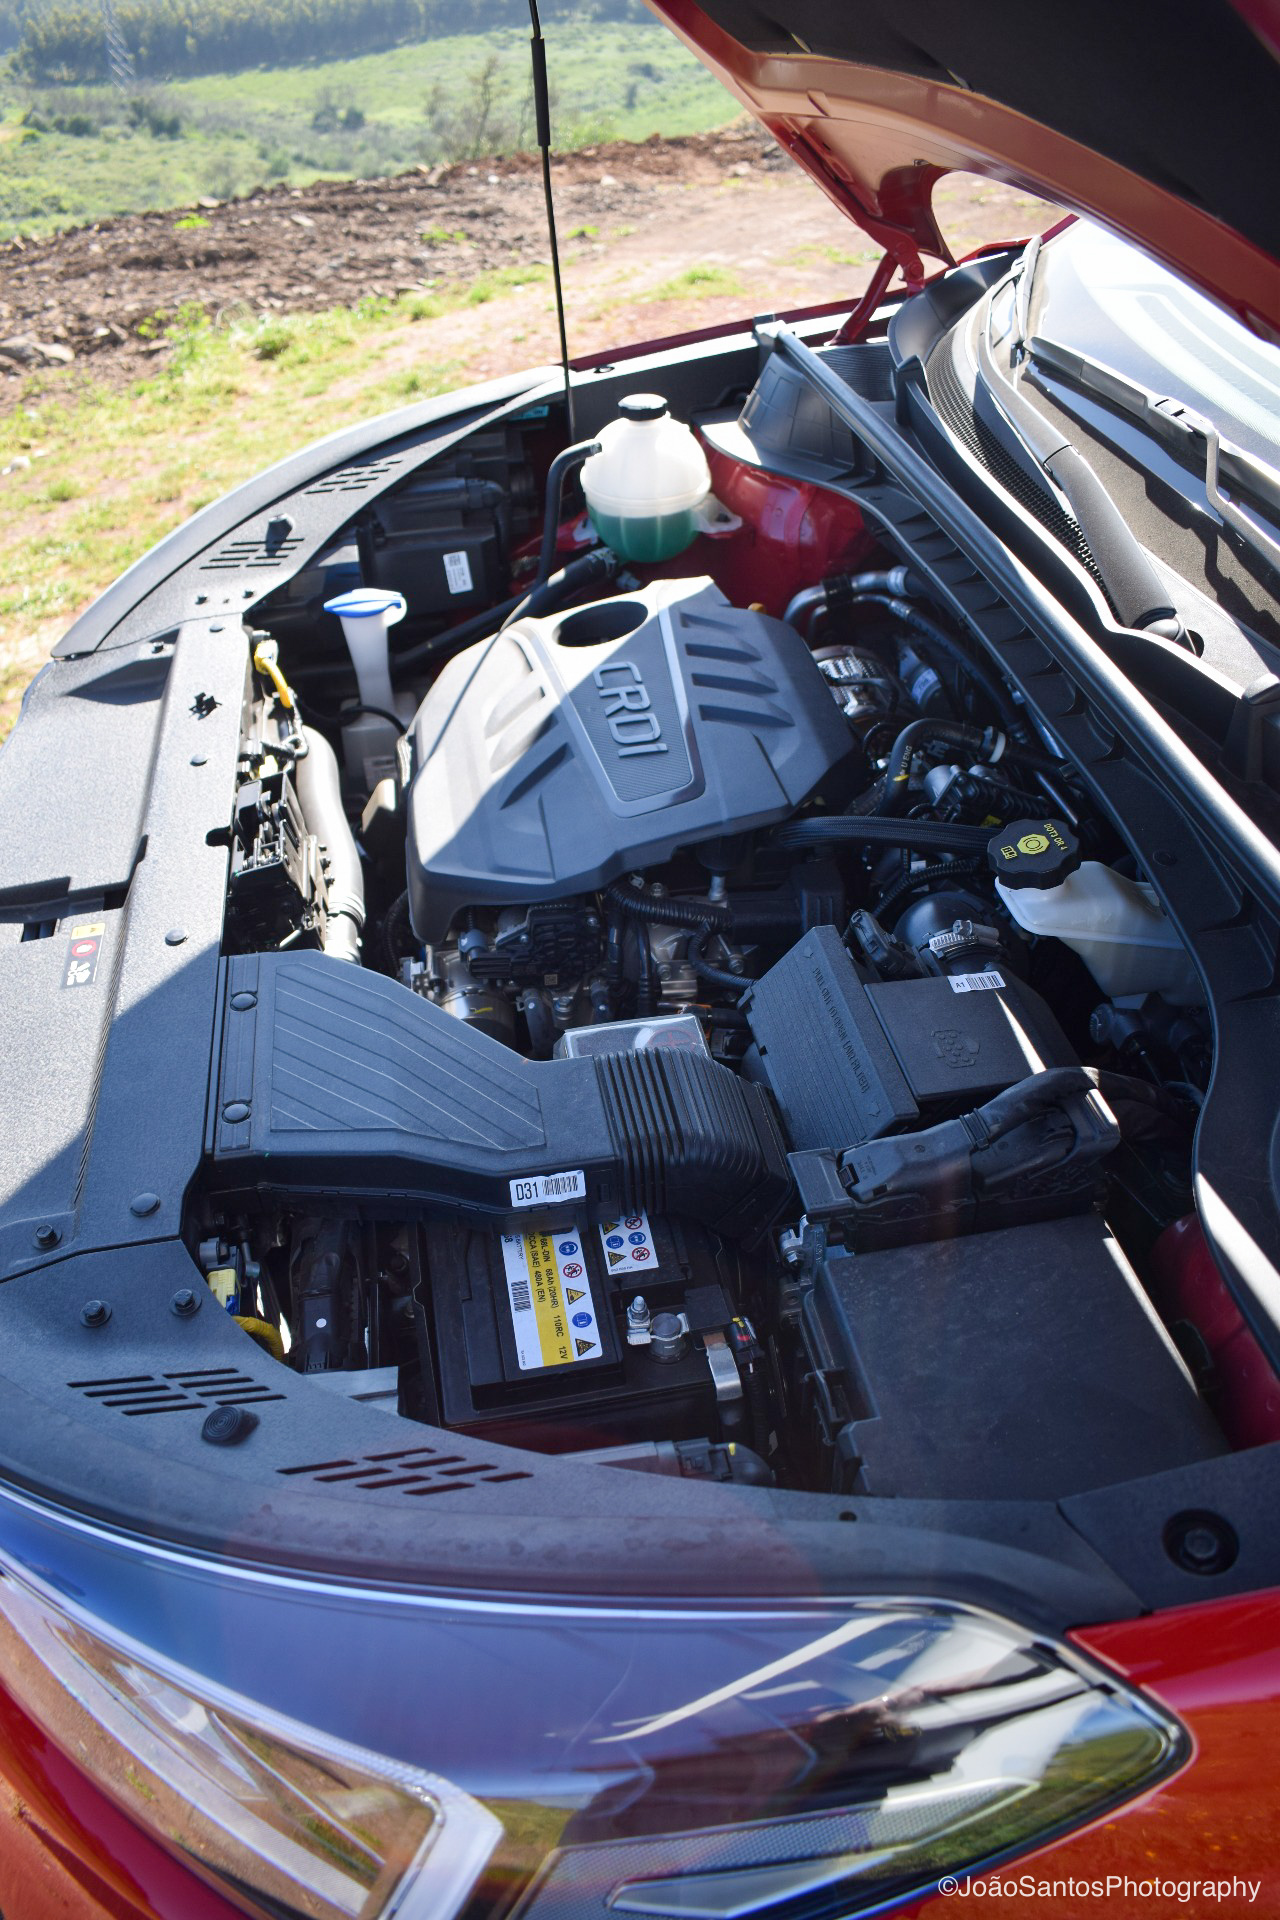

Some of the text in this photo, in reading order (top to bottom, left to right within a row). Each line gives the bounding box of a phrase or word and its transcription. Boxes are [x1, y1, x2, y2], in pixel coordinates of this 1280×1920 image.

[593, 661, 669, 758] CRDI
[1043, 823, 1059, 838] DOT3
[515, 1182, 540, 1201] D31
[530, 1250, 542, 1268] (SAE)
[534, 1270, 543, 1287] 480A
[535, 1288, 546, 1303] (EN)
[553, 1315, 564, 1338] 110RC
[558, 1346, 569, 1360] 12V
